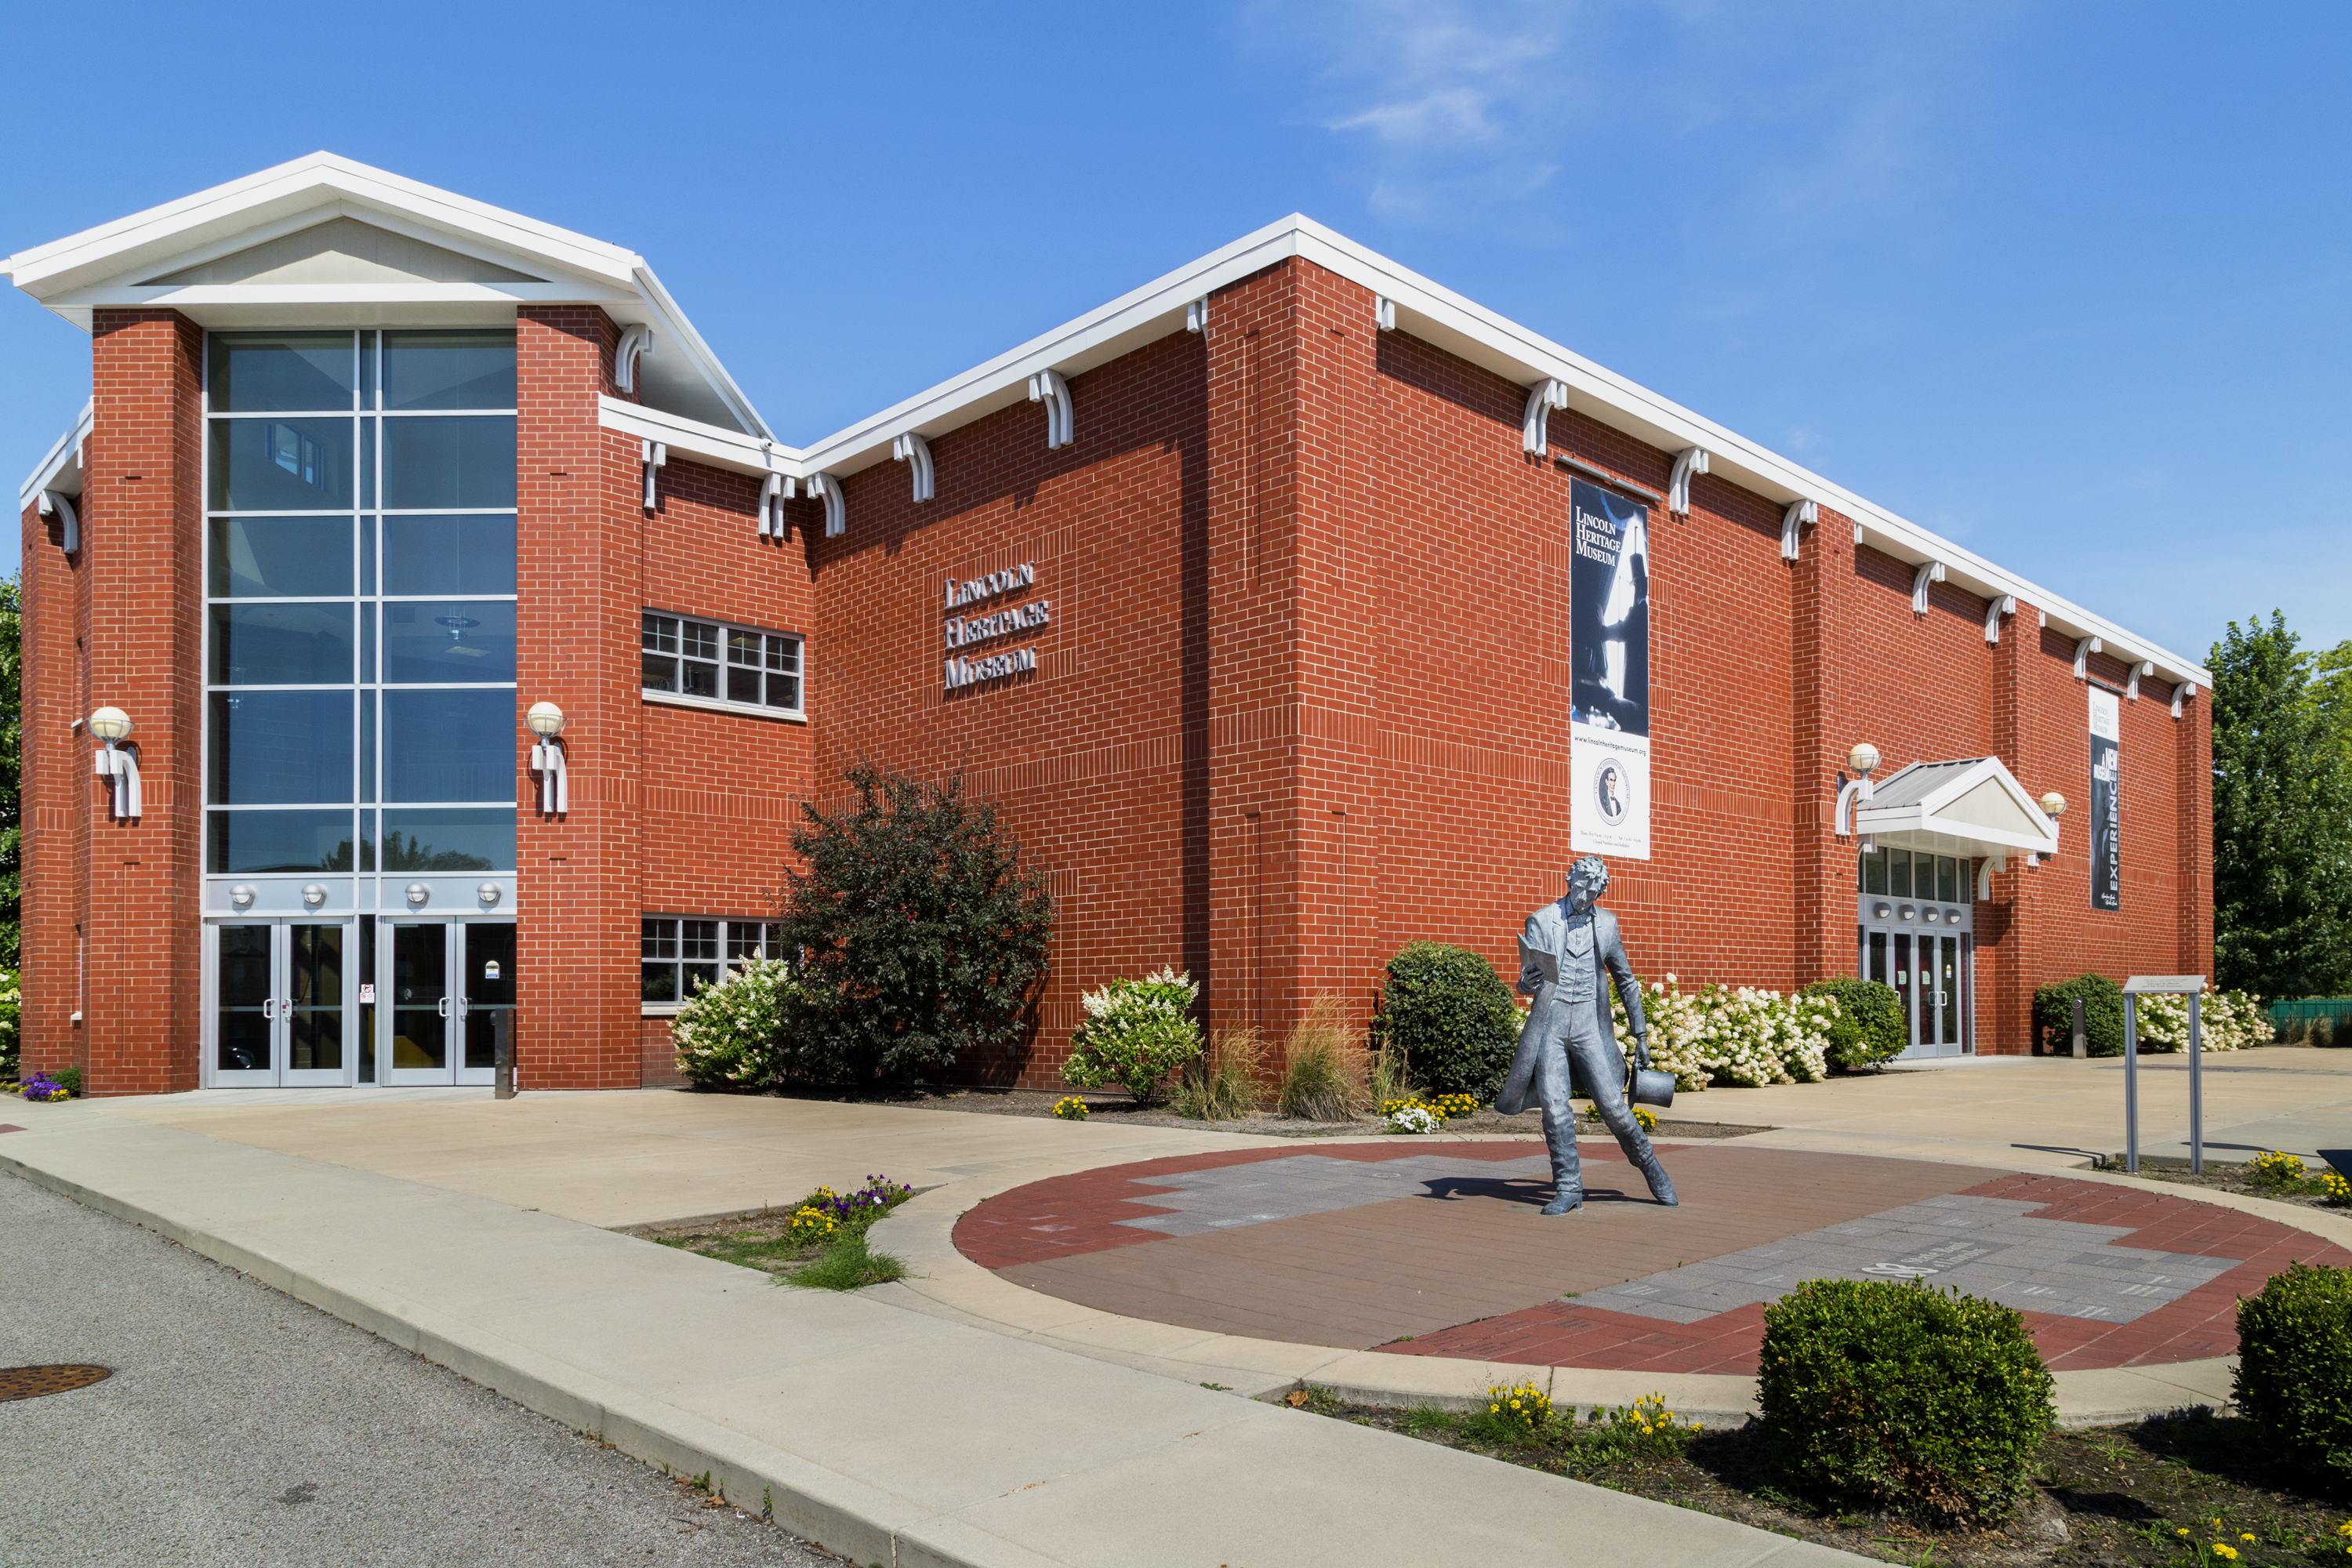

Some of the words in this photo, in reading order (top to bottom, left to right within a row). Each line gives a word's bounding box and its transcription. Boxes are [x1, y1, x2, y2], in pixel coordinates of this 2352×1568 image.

[1576, 506, 1616, 535] LINCOLN
[1576, 522, 1621, 553] HERITAGE
[1576, 538, 1616, 567] MUSEUM
[944, 561, 1035, 610] LINCOLN
[945, 600, 1049, 650] HERITAGE
[943, 646, 1037, 690] MUSEUM
[1574, 736, 1646, 757] www.lincolnheritagemuseum.org
[2105, 747, 2118, 771] NEW
[1900, 1247, 1944, 1264] State
[1943, 1242, 1975, 1254] Bank
[1934, 1248, 1991, 1265] Lincoln
